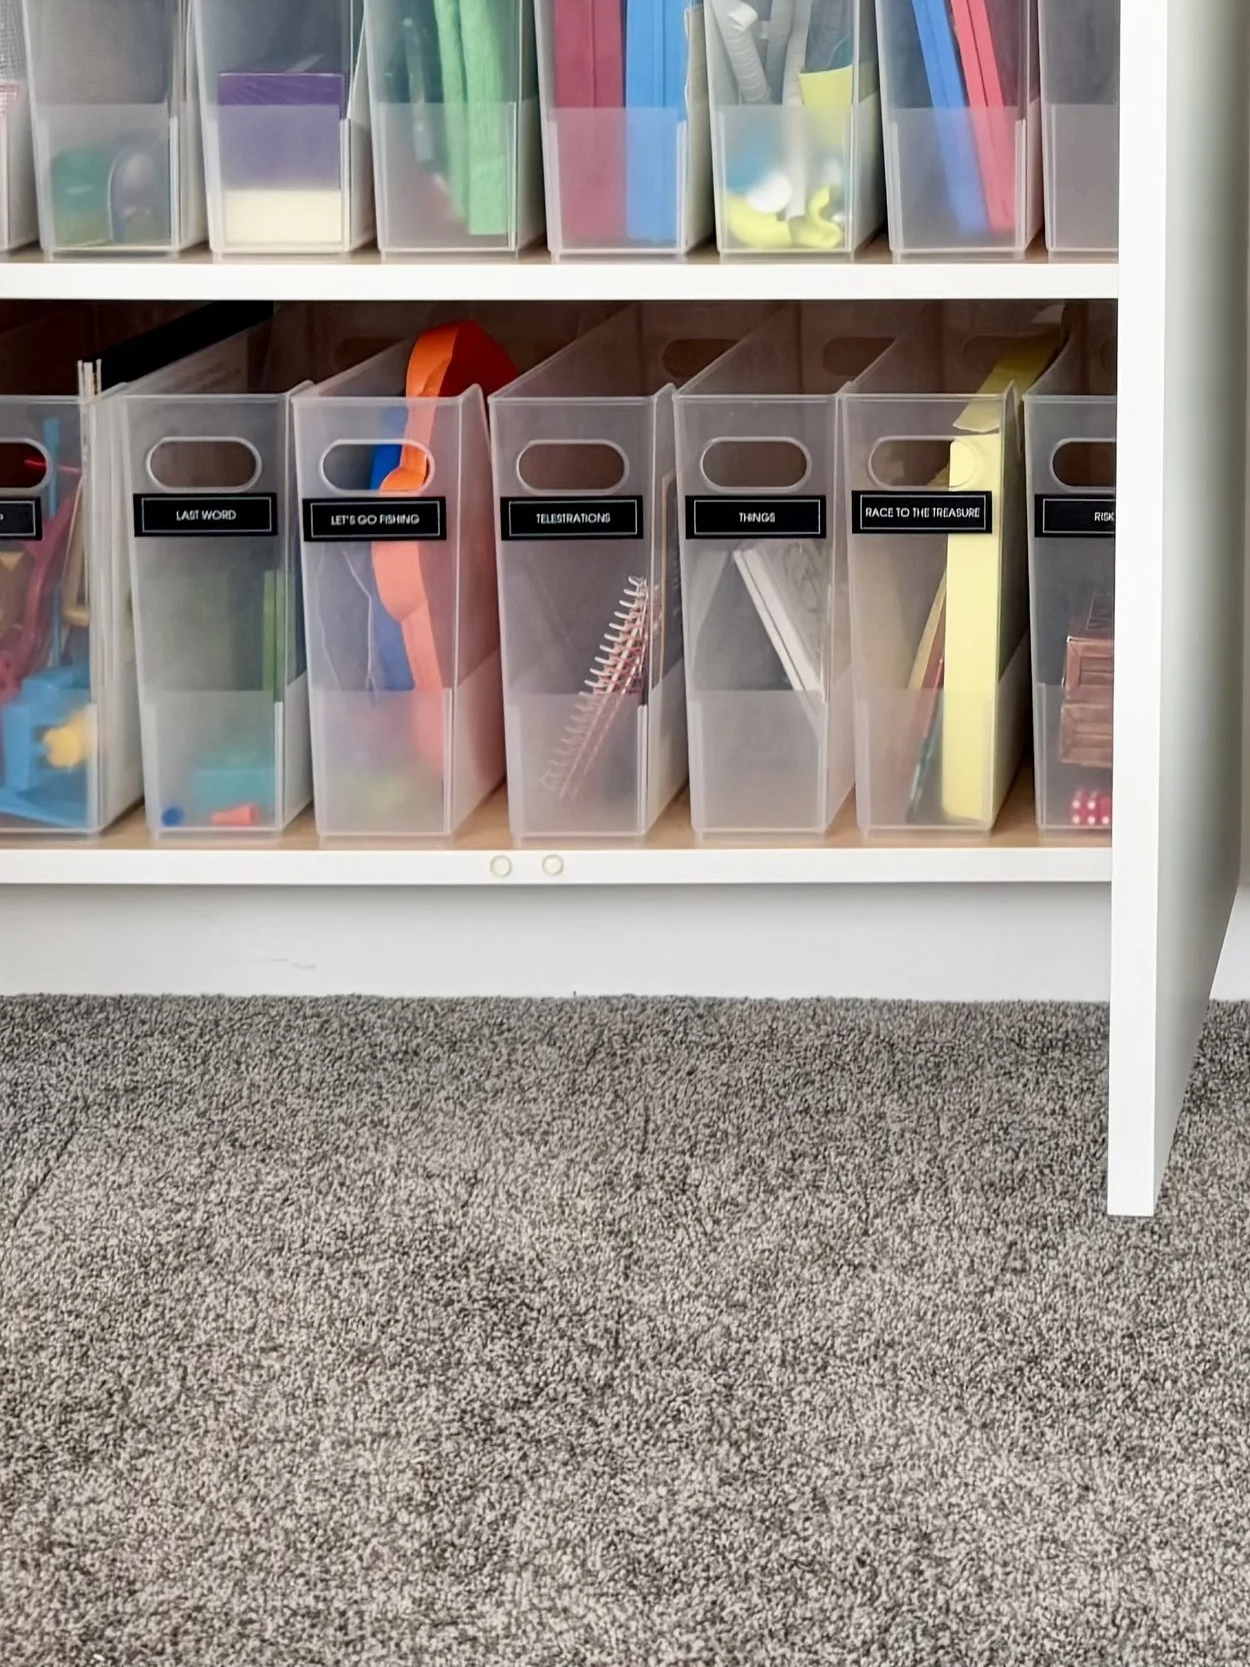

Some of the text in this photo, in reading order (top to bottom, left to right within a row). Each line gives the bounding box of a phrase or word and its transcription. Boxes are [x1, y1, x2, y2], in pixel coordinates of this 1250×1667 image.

[175, 509, 237, 522] LAST WORD
[330, 513, 420, 526] LET'S GO FISHING
[535, 512, 611, 525] TELESTRATIONS
[738, 511, 776, 524] THINGS
[865, 507, 981, 519] RACE TO THE TREASURE
[1094, 511, 1115, 522] RISK
